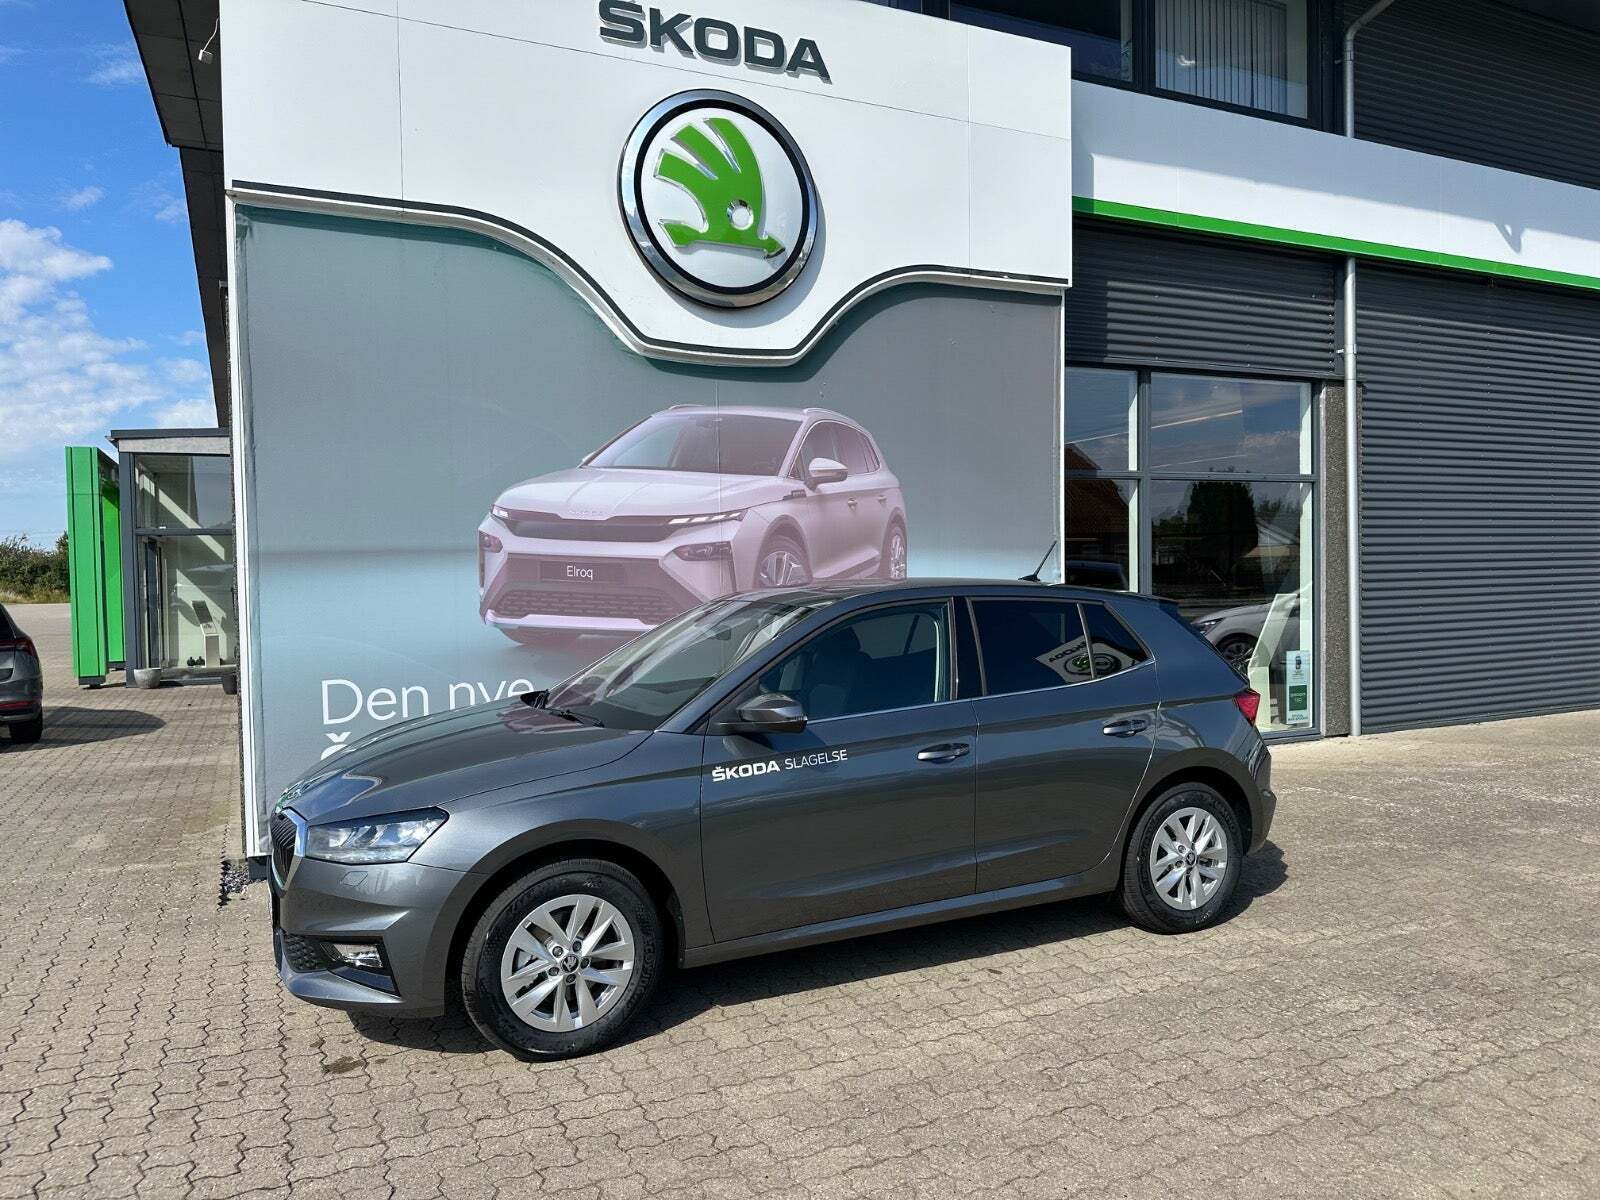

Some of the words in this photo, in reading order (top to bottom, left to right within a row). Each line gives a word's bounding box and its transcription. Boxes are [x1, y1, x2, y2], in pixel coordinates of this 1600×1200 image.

[566, 565, 593, 580] Elroq
[321, 679, 429, 725] Den
[711, 760, 780, 782] ŠKODA
[784, 749, 848, 769] SLAGELSE
